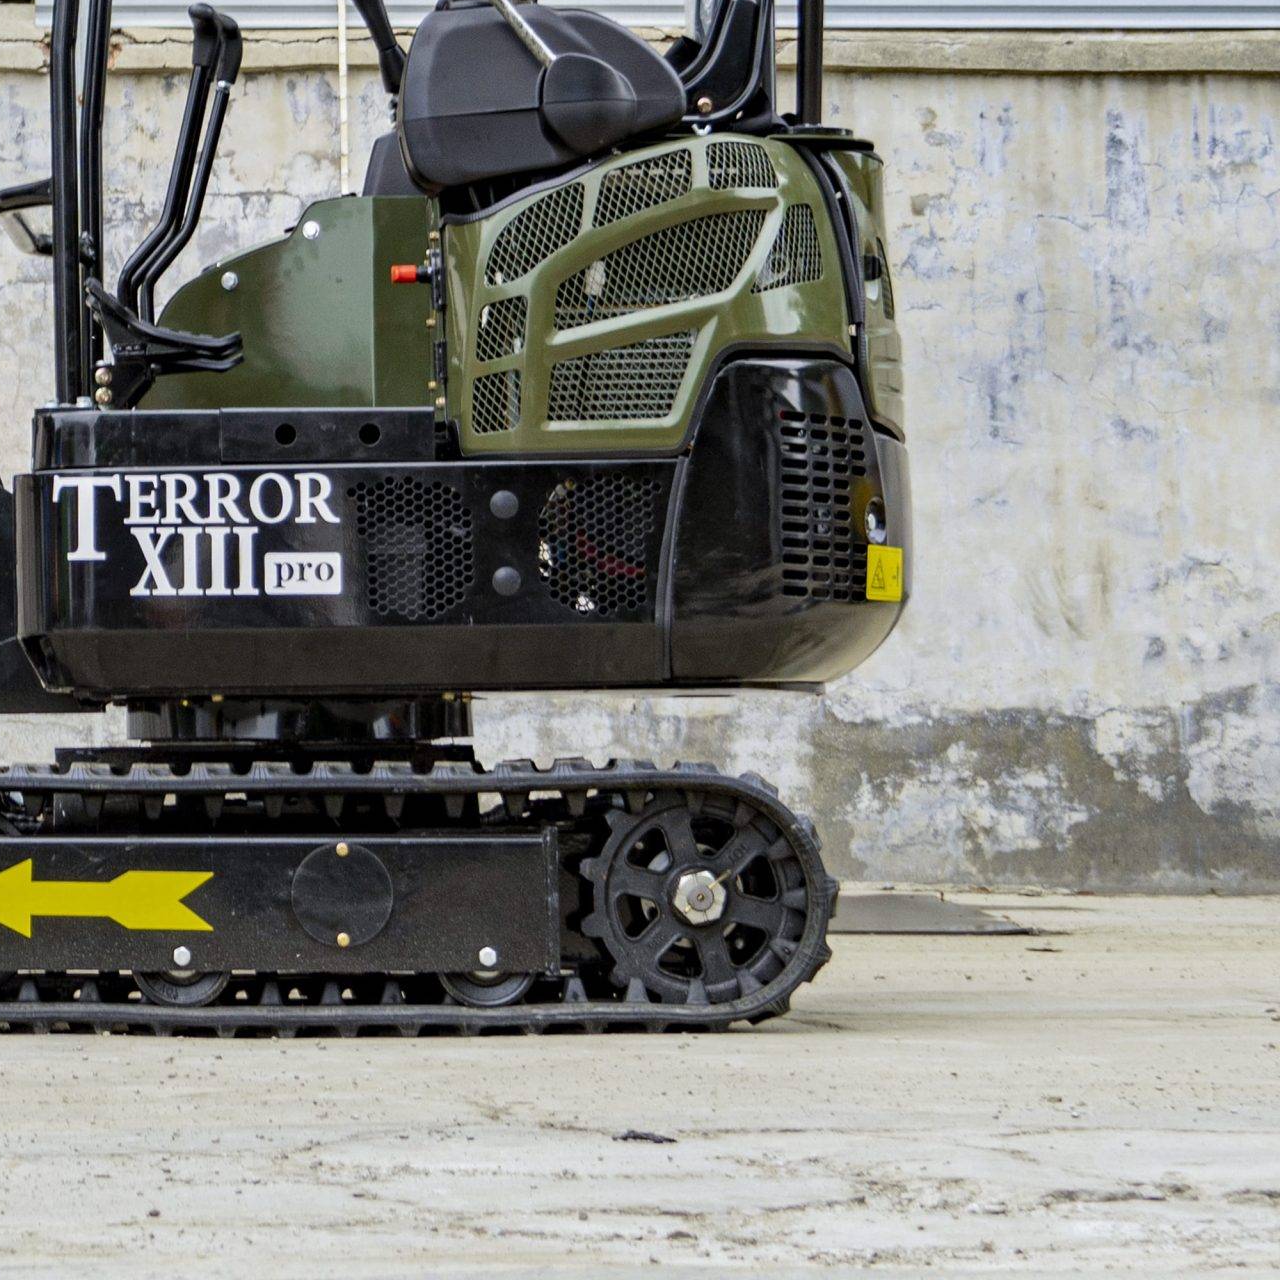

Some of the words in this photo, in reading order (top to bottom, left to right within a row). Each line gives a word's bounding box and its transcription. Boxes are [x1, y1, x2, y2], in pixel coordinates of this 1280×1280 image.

[52, 472, 341, 561] TERROR
[129, 525, 260, 596] XIII
[273, 560, 335, 591] pro
